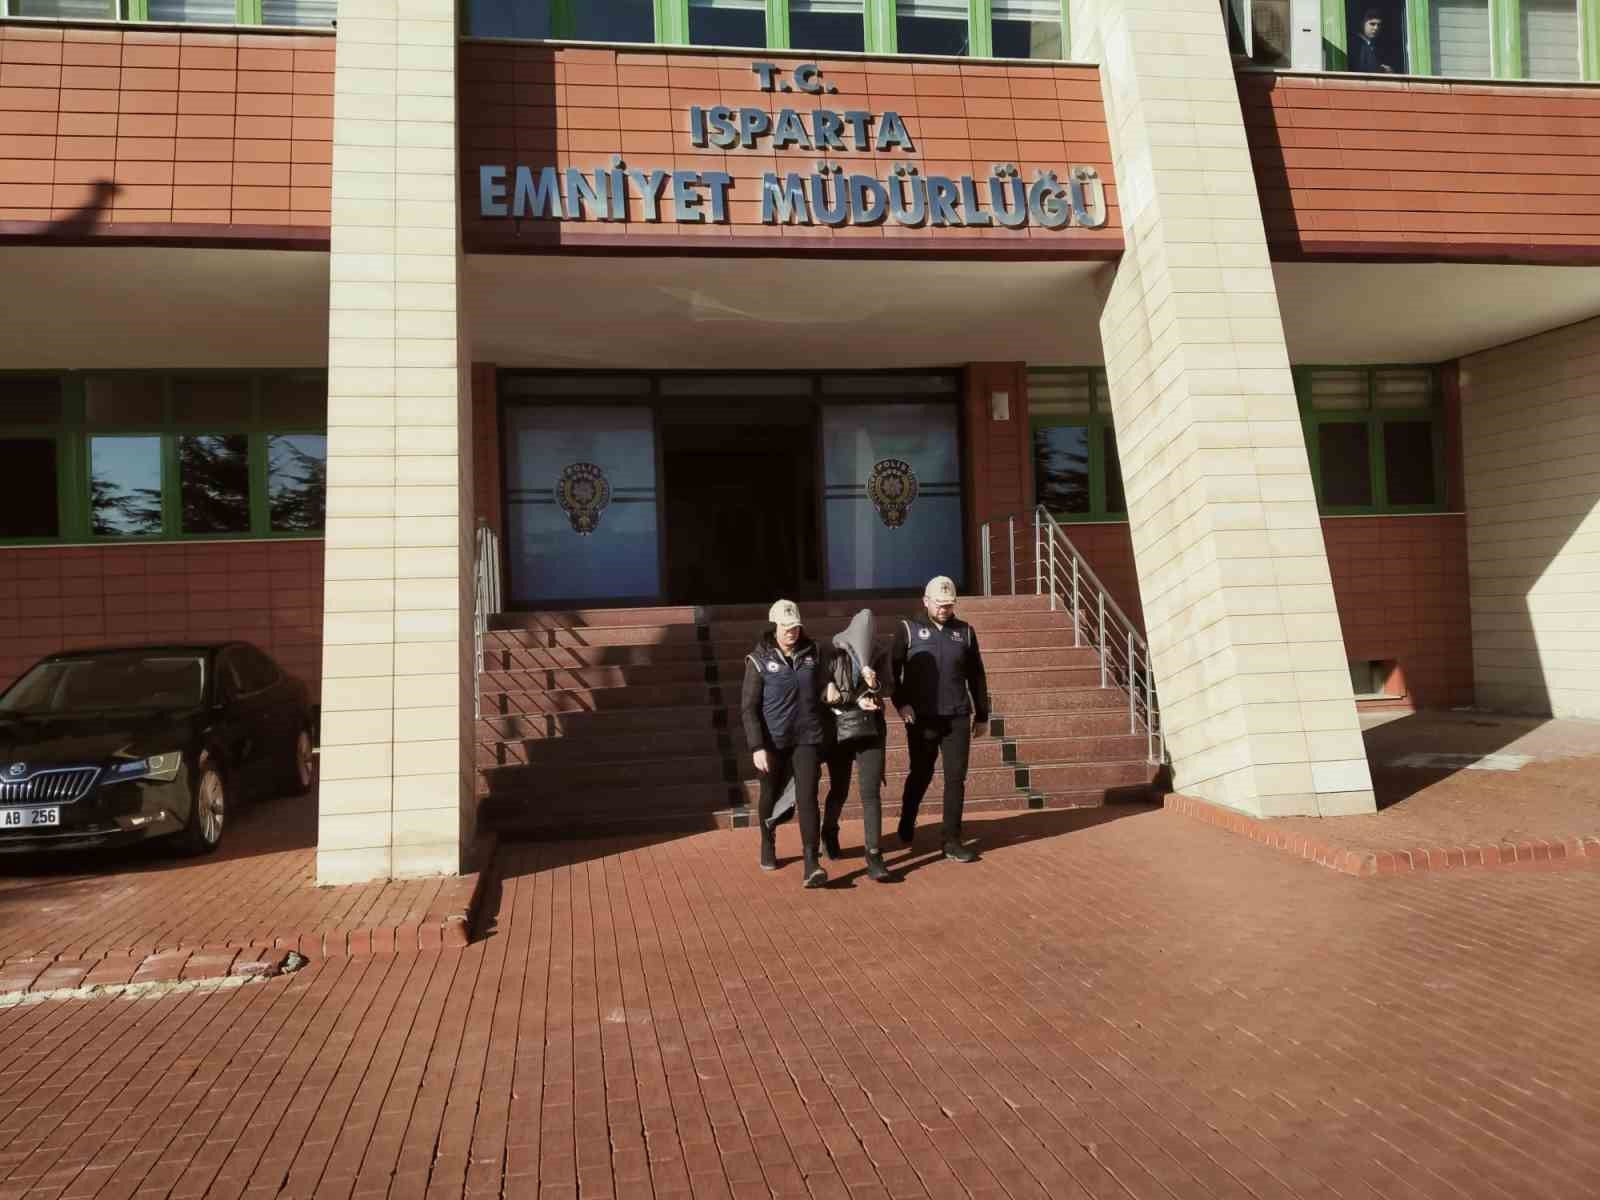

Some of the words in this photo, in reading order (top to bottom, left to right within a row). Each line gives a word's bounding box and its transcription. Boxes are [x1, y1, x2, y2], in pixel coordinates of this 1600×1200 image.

[752, 63, 838, 93] T.C.
[690, 106, 914, 151] ISPARTA
[480, 153, 731, 223] EMNİYET
[761, 161, 1107, 229] MÜDÜRLÜĞÜ
[32, 809, 56, 824] 256
